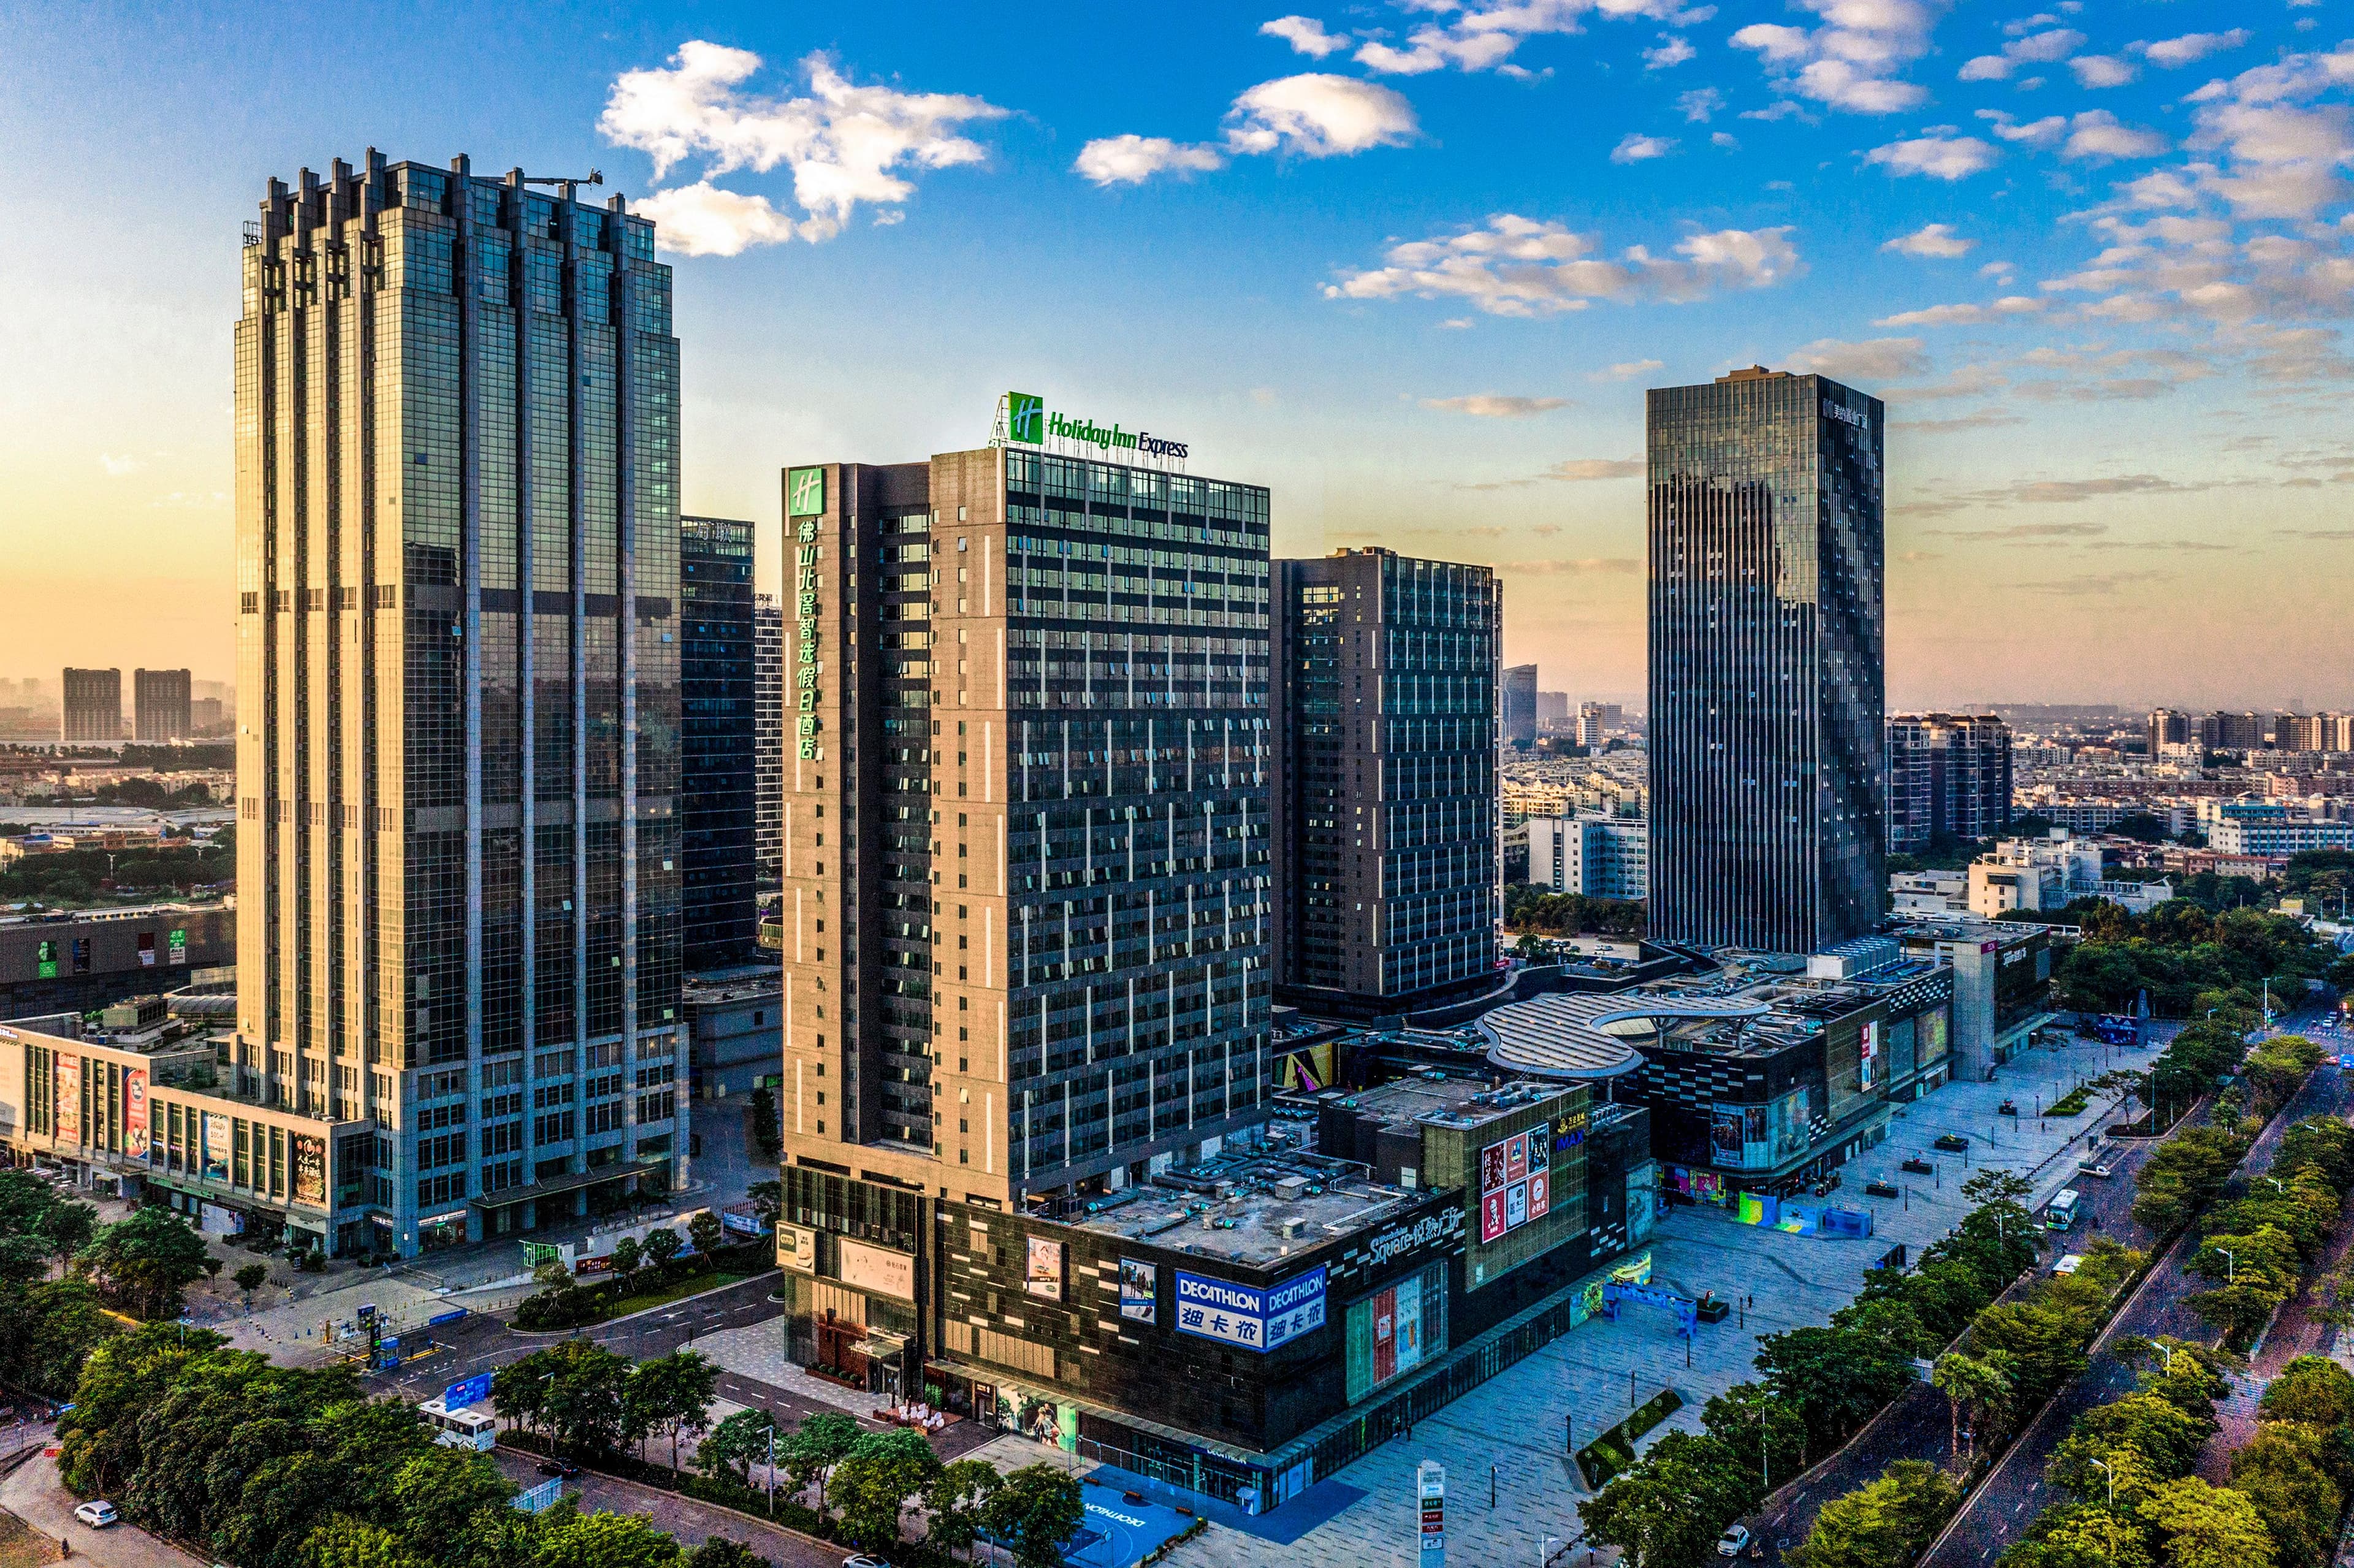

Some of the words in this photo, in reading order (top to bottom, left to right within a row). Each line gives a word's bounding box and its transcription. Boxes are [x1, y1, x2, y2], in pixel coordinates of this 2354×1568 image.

[1048, 411, 1112, 449] Holiday
[1113, 424, 1137, 449] Inn
[1138, 432, 1188, 459] Express
[797, 520, 815, 760] 佛山北滘智选假日酒店
[1556, 1128, 1585, 1153] IMAX
[1370, 1233, 1411, 1265] Square
[1179, 1279, 1260, 1312] DECATHLON
[1269, 1276, 1323, 1312] DECATHLON
[1182, 1307, 1257, 1341] 迪卡侬
[1270, 1303, 1322, 1342] 迪卡侬
[1083, 1502, 1146, 1527] DECATHLON
